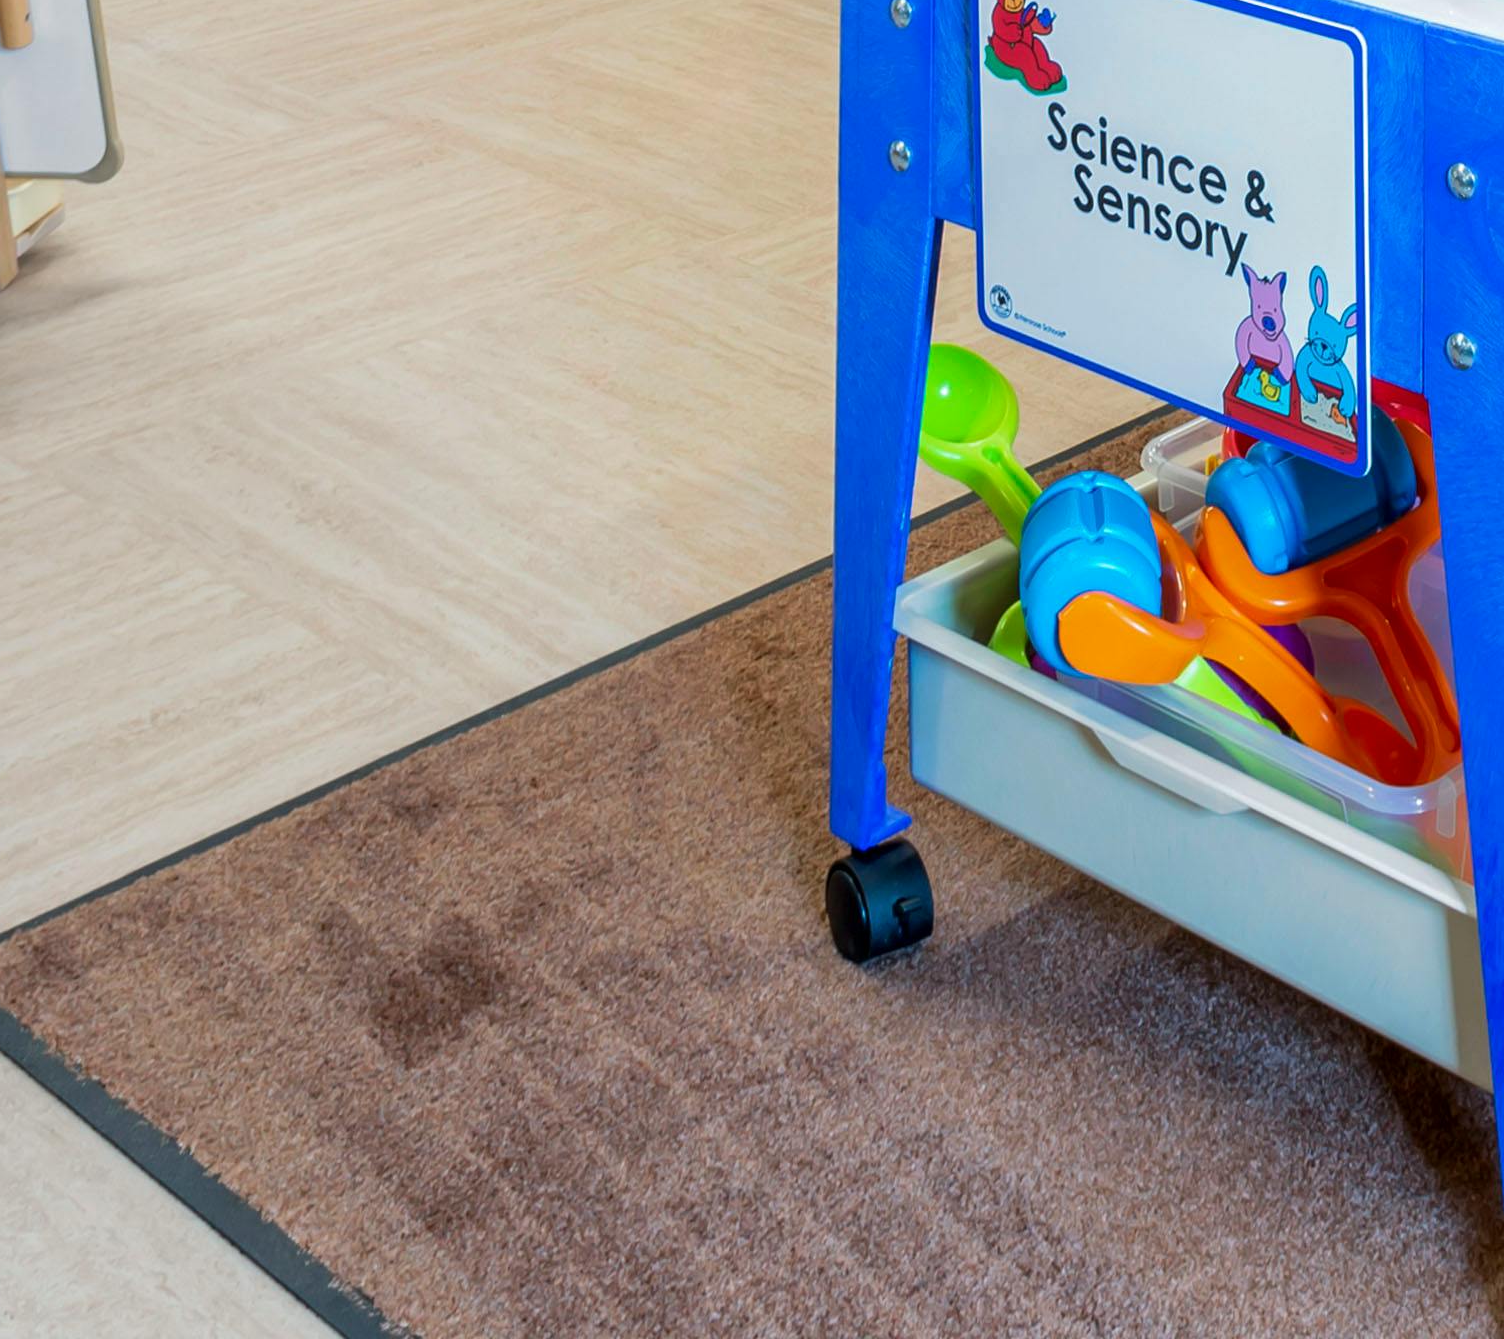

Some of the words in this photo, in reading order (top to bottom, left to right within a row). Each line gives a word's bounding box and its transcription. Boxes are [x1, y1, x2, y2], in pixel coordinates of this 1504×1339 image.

[1046, 101, 1228, 205] Science
[1244, 169, 1276, 223] &
[1073, 163, 1248, 276] Sensory
